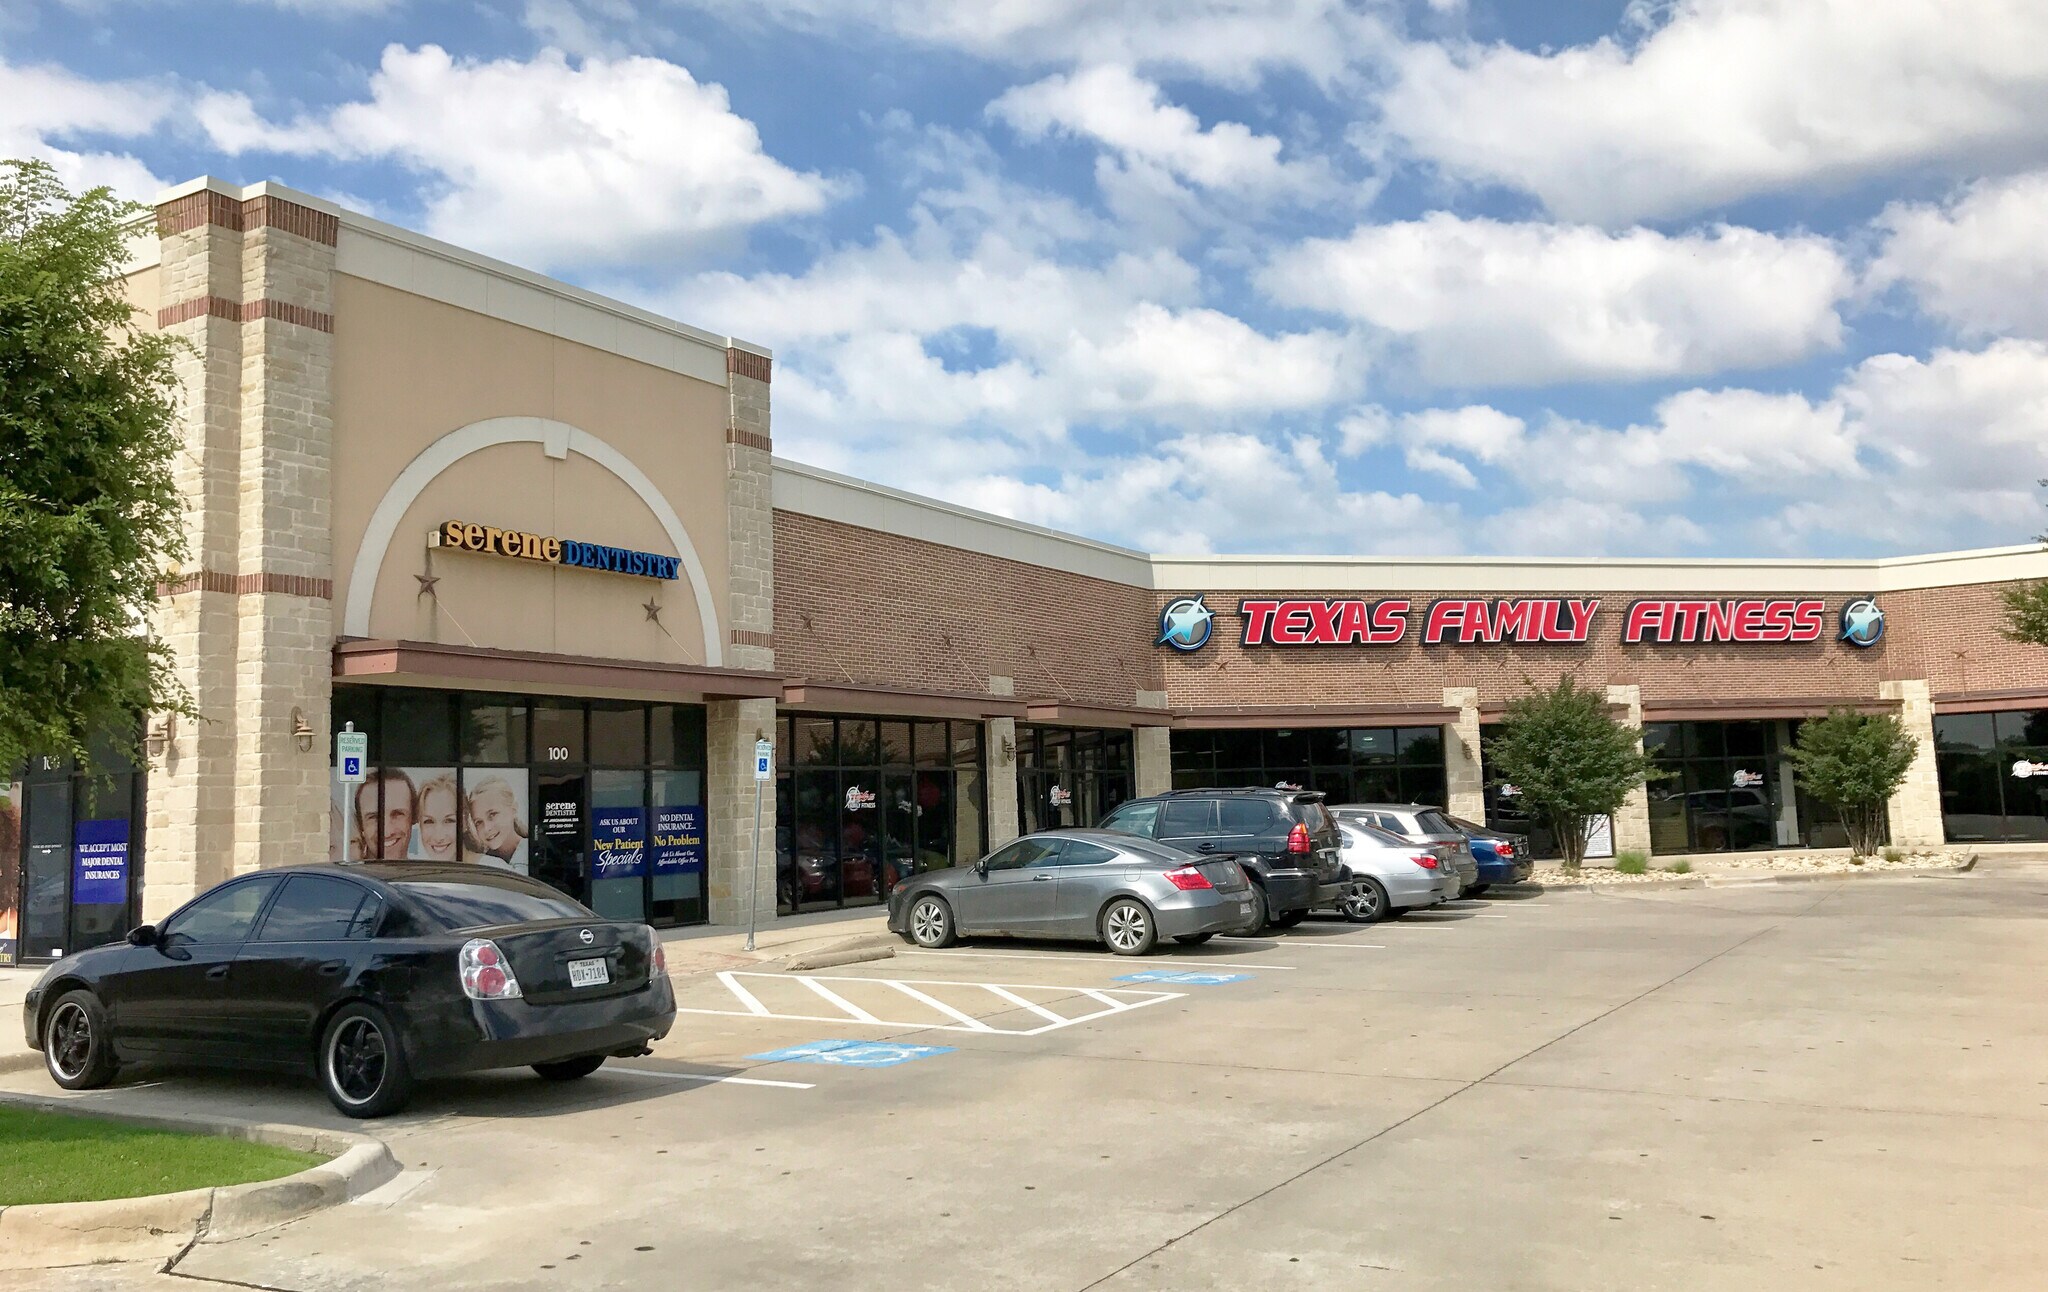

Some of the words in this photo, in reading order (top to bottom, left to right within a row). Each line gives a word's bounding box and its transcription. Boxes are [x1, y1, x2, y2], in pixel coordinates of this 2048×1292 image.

[444, 519, 561, 562] serene
[563, 540, 682, 580] DENTISTRY
[1240, 599, 1411, 645] TEXAS
[1424, 599, 1601, 644] FAMILY
[1624, 599, 1826, 643] FITNESS
[341, 745, 364, 753] PARKING
[548, 747, 569, 760] 100
[545, 802, 577, 810] serene
[660, 814, 670, 822] NO
[671, 813, 695, 821] DENTAL
[594, 839, 613, 851] New
[615, 838, 644, 850] Patient
[654, 835, 667, 847] No
[668, 834, 700, 846] Problem
[79, 844, 89, 853] WE
[89, 843, 111, 852] ACCEPT
[111, 842, 128, 852] MOST
[81, 857, 102, 868] MAJOR
[102, 856, 125, 866] DENTAL
[595, 848, 643, 873] Specials
[85, 870, 120, 880] INSURANCES
